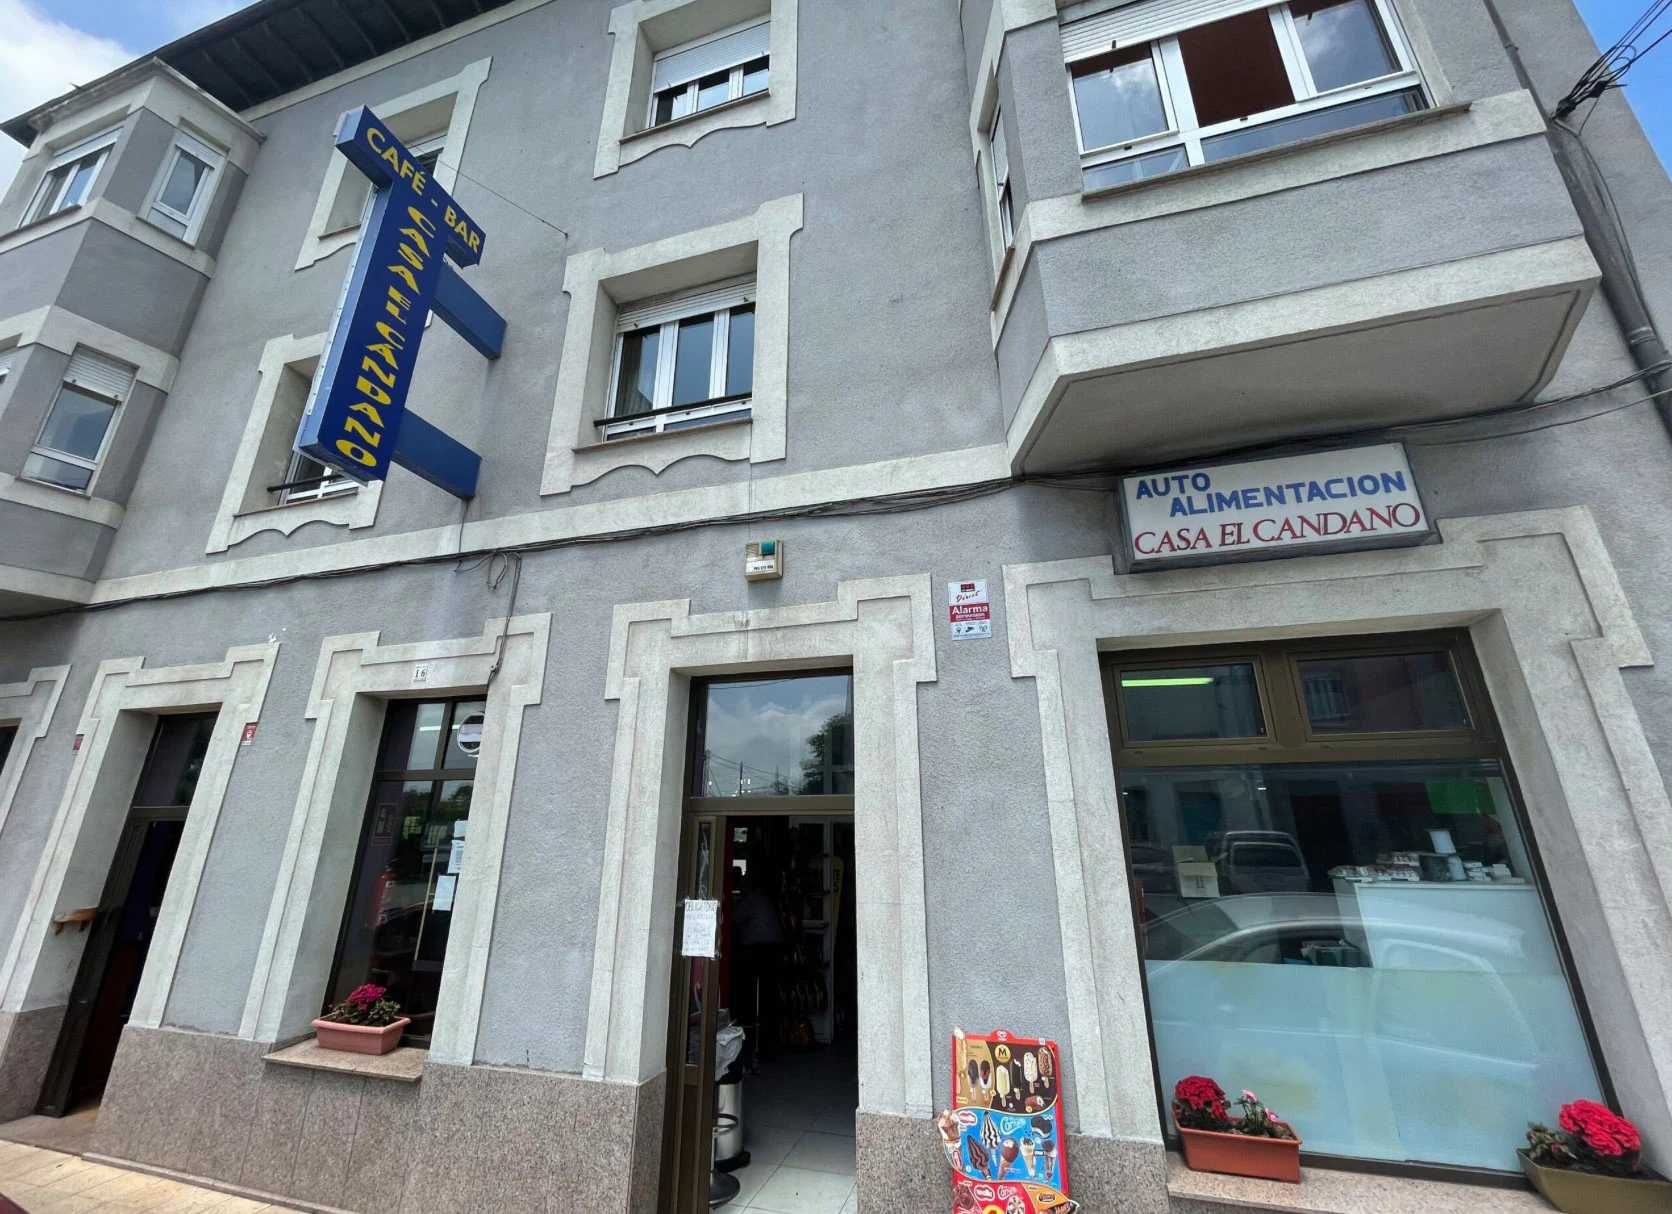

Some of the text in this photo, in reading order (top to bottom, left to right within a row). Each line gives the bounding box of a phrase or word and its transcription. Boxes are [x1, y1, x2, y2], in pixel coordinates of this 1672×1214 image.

[366, 127, 426, 196] CAFÉ
[444, 204, 480, 254] BAR
[336, 205, 435, 468] CASA EL CANDANO
[1136, 472, 1211, 500] AUTO
[1169, 471, 1406, 518] ALIMENTACION
[1134, 502, 1421, 555] CASA EL CANDANO
[952, 605, 988, 615] Alarma
[415, 668, 426, 678] 16
[998, 1047, 1007, 1056] M
